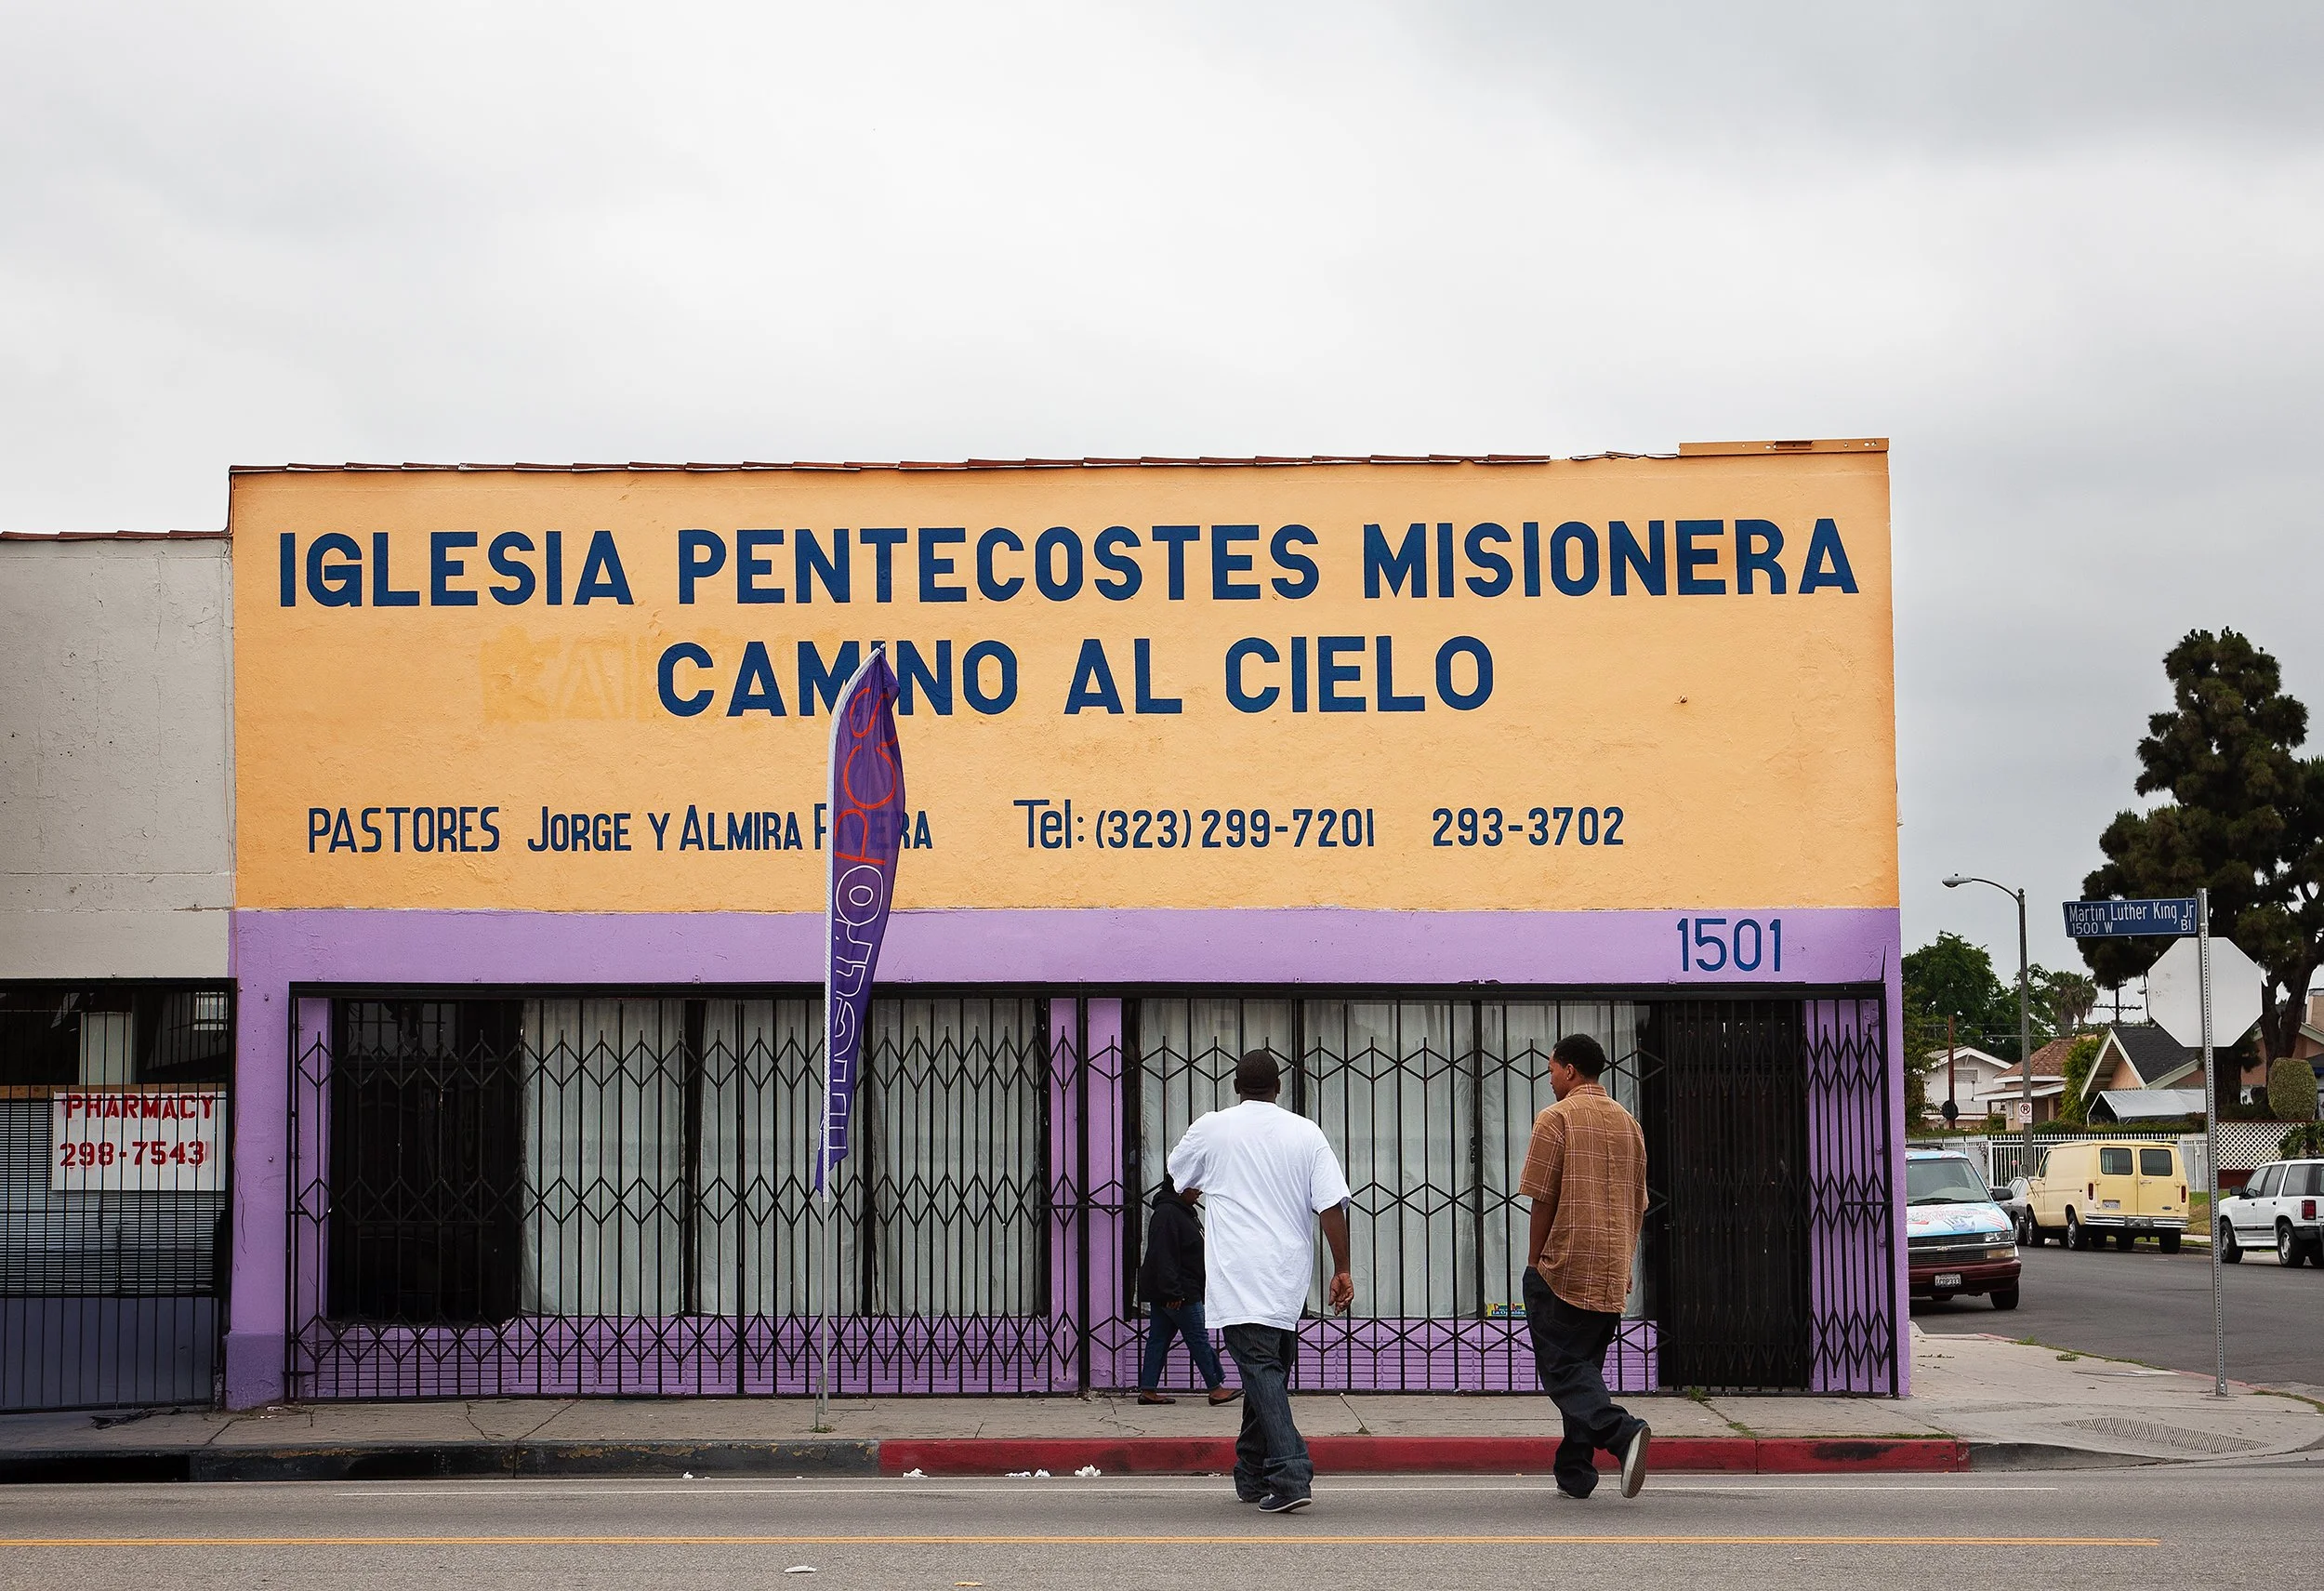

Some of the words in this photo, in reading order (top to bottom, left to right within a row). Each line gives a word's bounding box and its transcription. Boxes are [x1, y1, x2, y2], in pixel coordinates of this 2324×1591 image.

[280, 530, 634, 607] IGLESIA
[678, 524, 1320, 605] PENTECOSTES
[1363, 518, 1859, 600] MISIONERA
[657, 639, 1019, 716] CAMNO
[1064, 638, 1182, 715] AL
[1225, 635, 1494, 713] CIELO
[309, 806, 500, 853] PASTORES
[527, 806, 632, 852] JORGE
[648, 813, 670, 851] Y
[680, 804, 803, 851] ALMIRA
[1013, 799, 1086, 849] Tel:
[1095, 809, 1193, 849] (323)
[1201, 808, 1375, 848] 299-7201
[1433, 806, 1625, 847] 293-3702
[2069, 905, 2106, 922] Martin
[2110, 903, 2147, 921] Luther
[2153, 901, 2177, 924] King
[2183, 901, 2194, 919] Jr
[2072, 922, 2098, 935] 1500
[2105, 921, 2113, 934] W
[1676, 918, 1783, 973] 1501
[65, 1094, 215, 1120] PHARMACY
[59, 1141, 205, 1167] 298-7543
